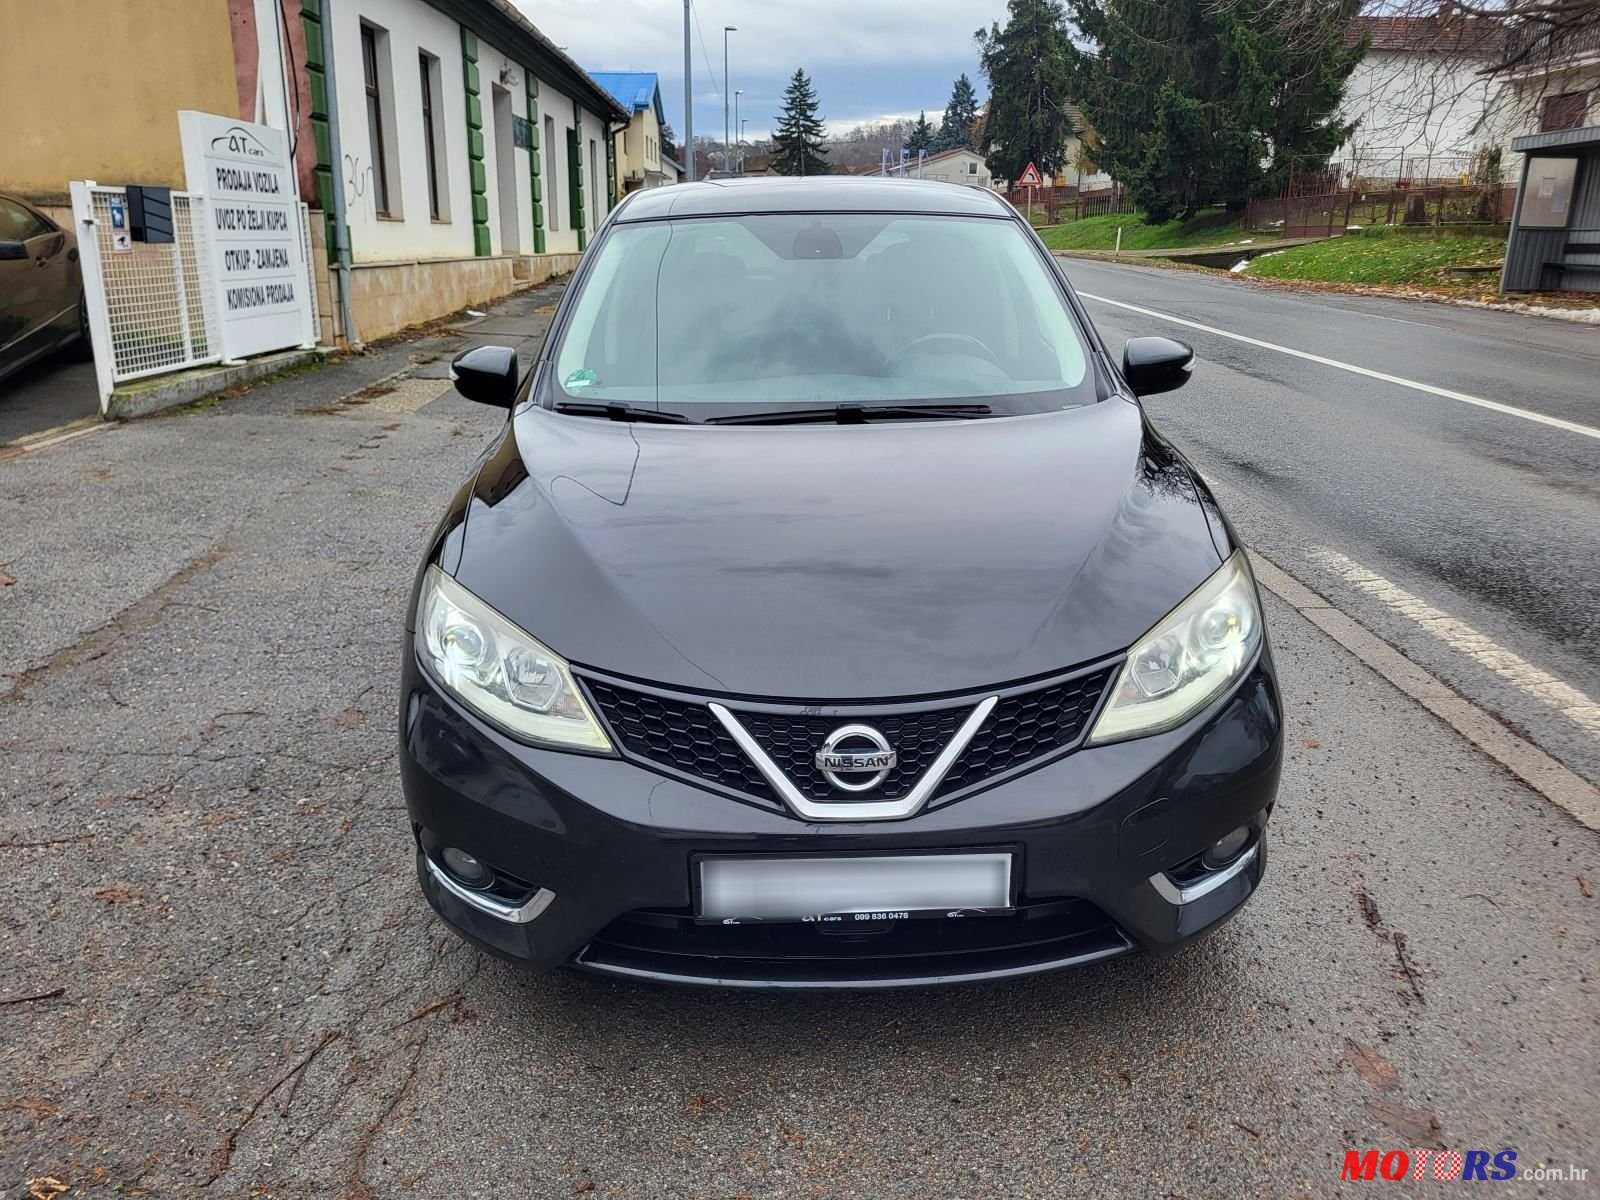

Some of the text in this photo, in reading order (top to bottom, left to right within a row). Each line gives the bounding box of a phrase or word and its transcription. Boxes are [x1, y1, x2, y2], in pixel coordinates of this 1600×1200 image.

[248, 148, 264, 157] cars
[216, 167, 280, 194] PRODAJA VOZILA
[215, 204, 289, 231] UVOZ PO ŽELJI KUPCA
[225, 249, 251, 271] OTKUP
[256, 248, 289, 269] ZAMJENA
[227, 282, 295, 310] KOMISIONA PRODAJA
[824, 756, 889, 768] NISSAN
